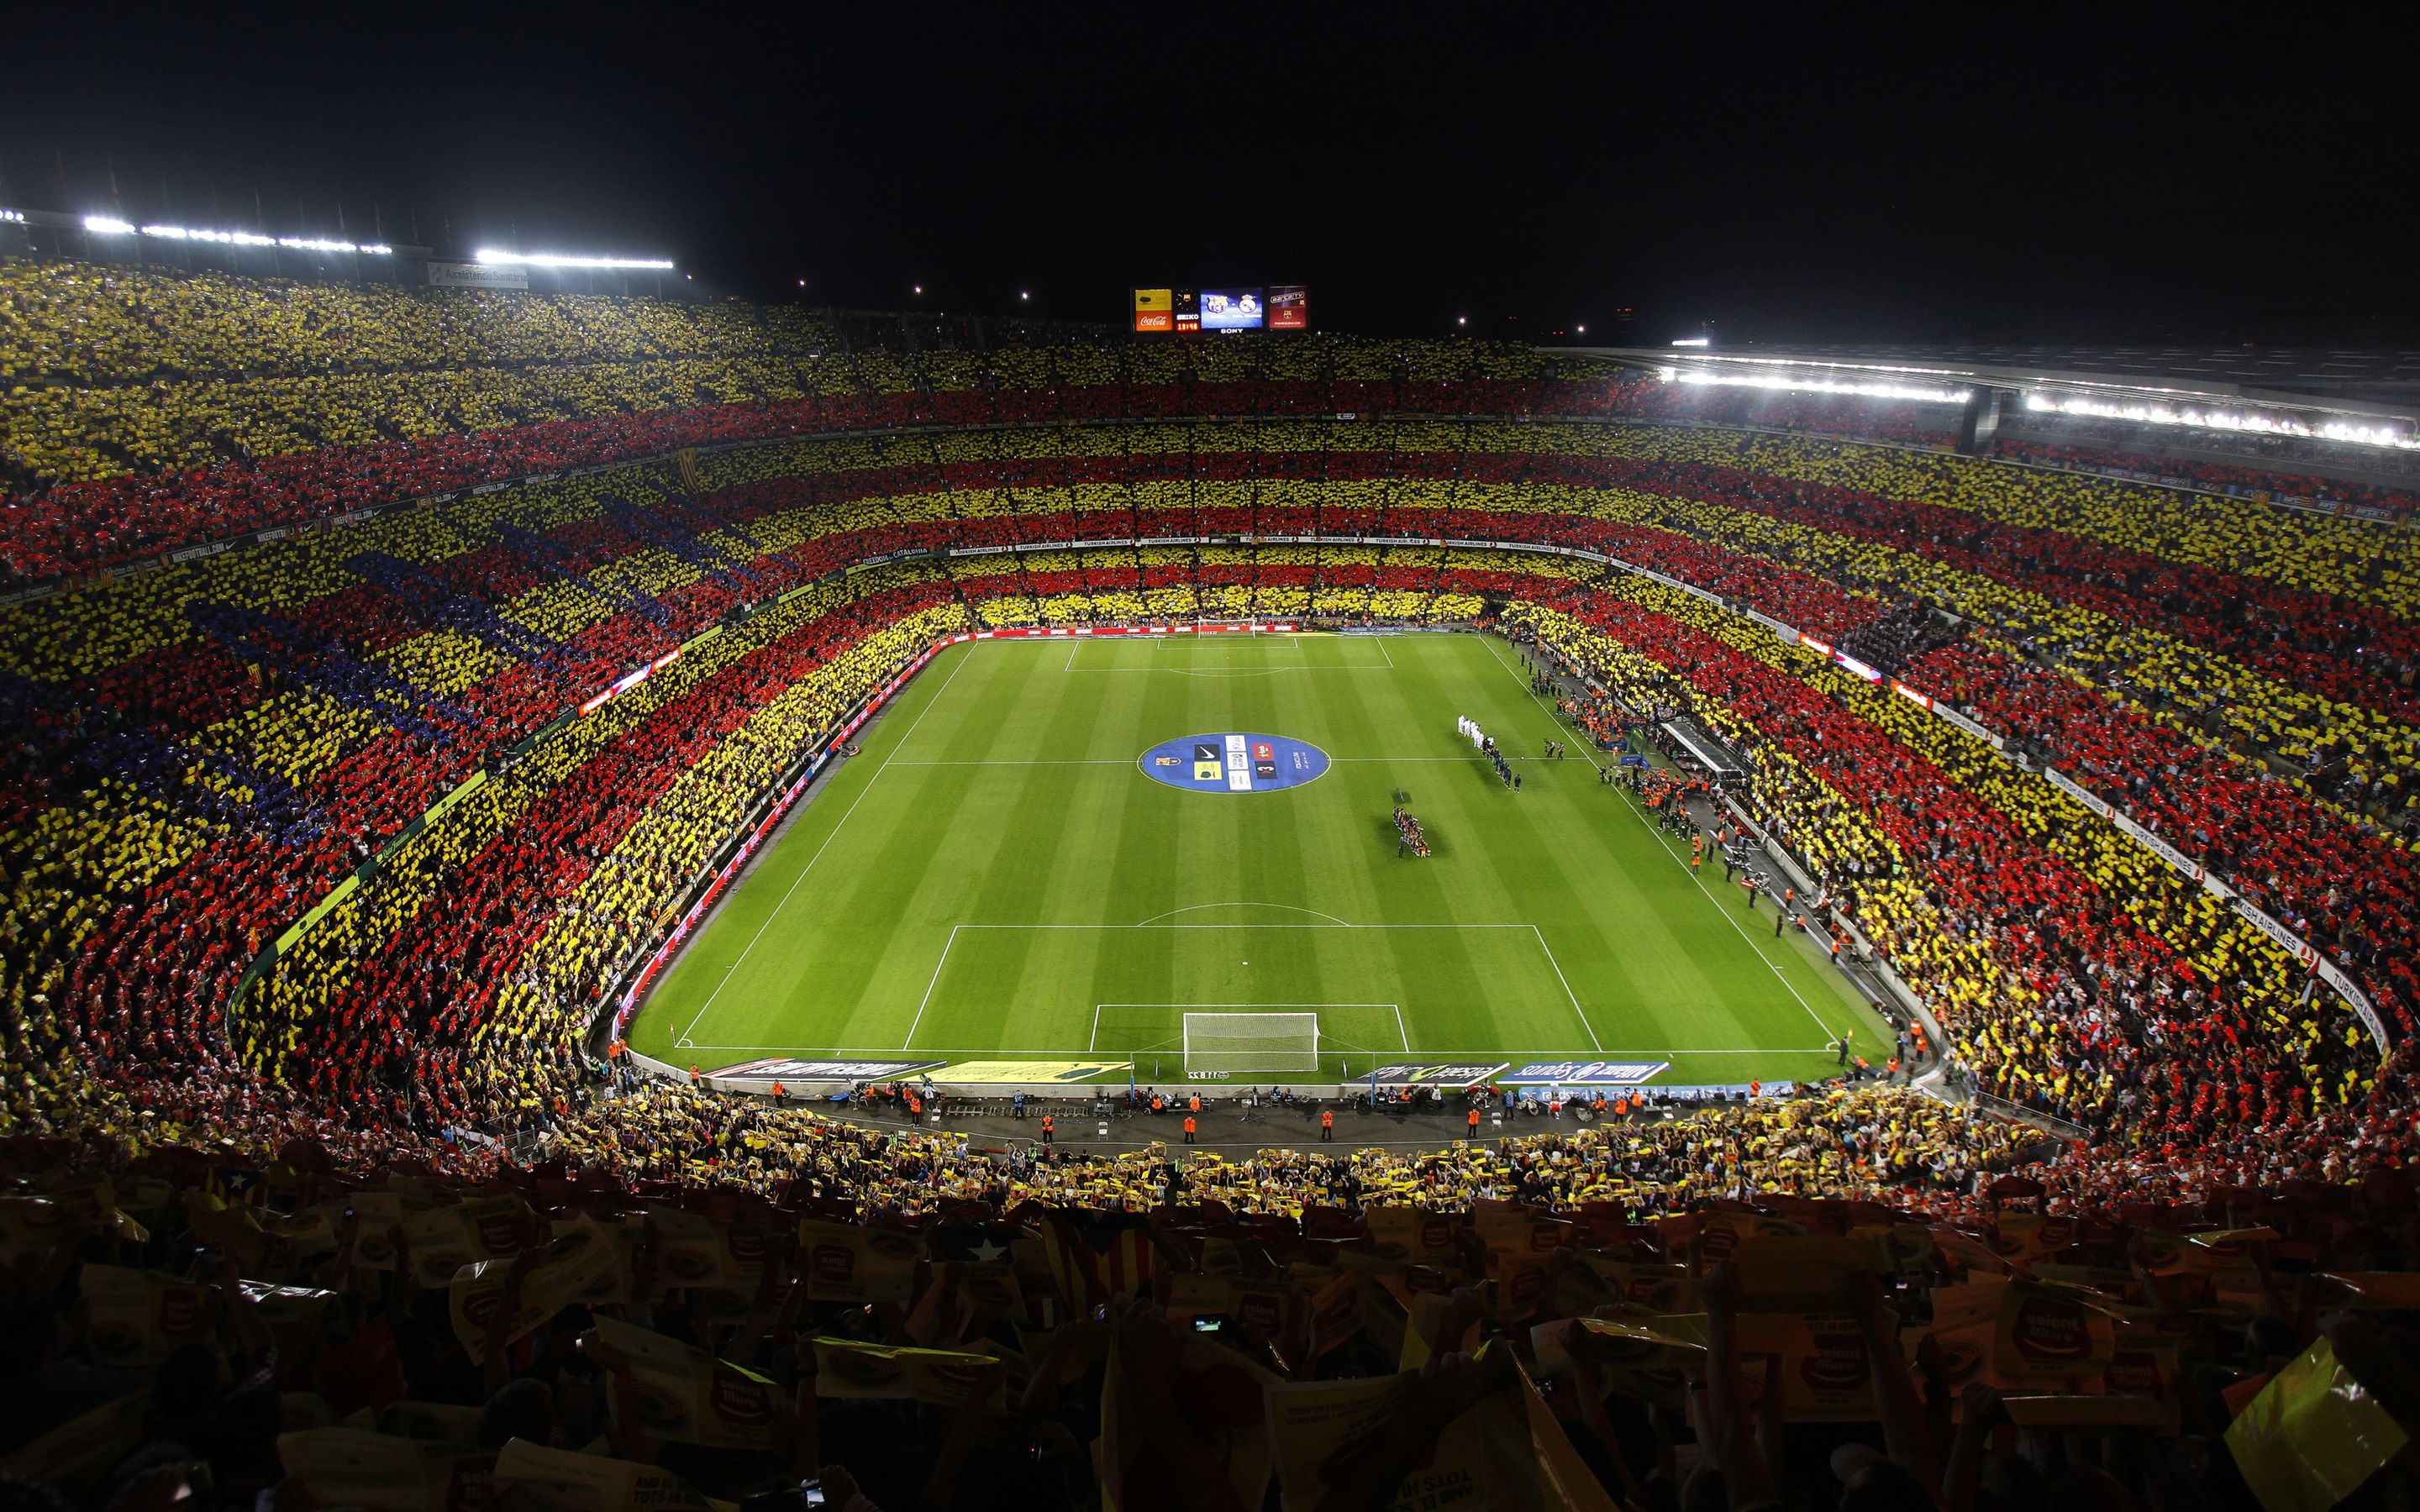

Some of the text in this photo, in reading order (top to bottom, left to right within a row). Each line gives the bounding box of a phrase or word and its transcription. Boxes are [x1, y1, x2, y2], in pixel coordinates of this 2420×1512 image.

[863, 555, 889, 565] FREEDOM
[893, 548, 928, 558] CATALONIA
[2076, 788, 2104, 813] AIRLINES
[2130, 824, 2192, 873] TURKISH AIRLINES
[2258, 914, 2297, 950] AIRLINES
[2333, 973, 2365, 1012] TURKISH
[1515, 1062, 1657, 1079] Allianz Seguros
[1423, 1470, 1469, 1493] TOTS
